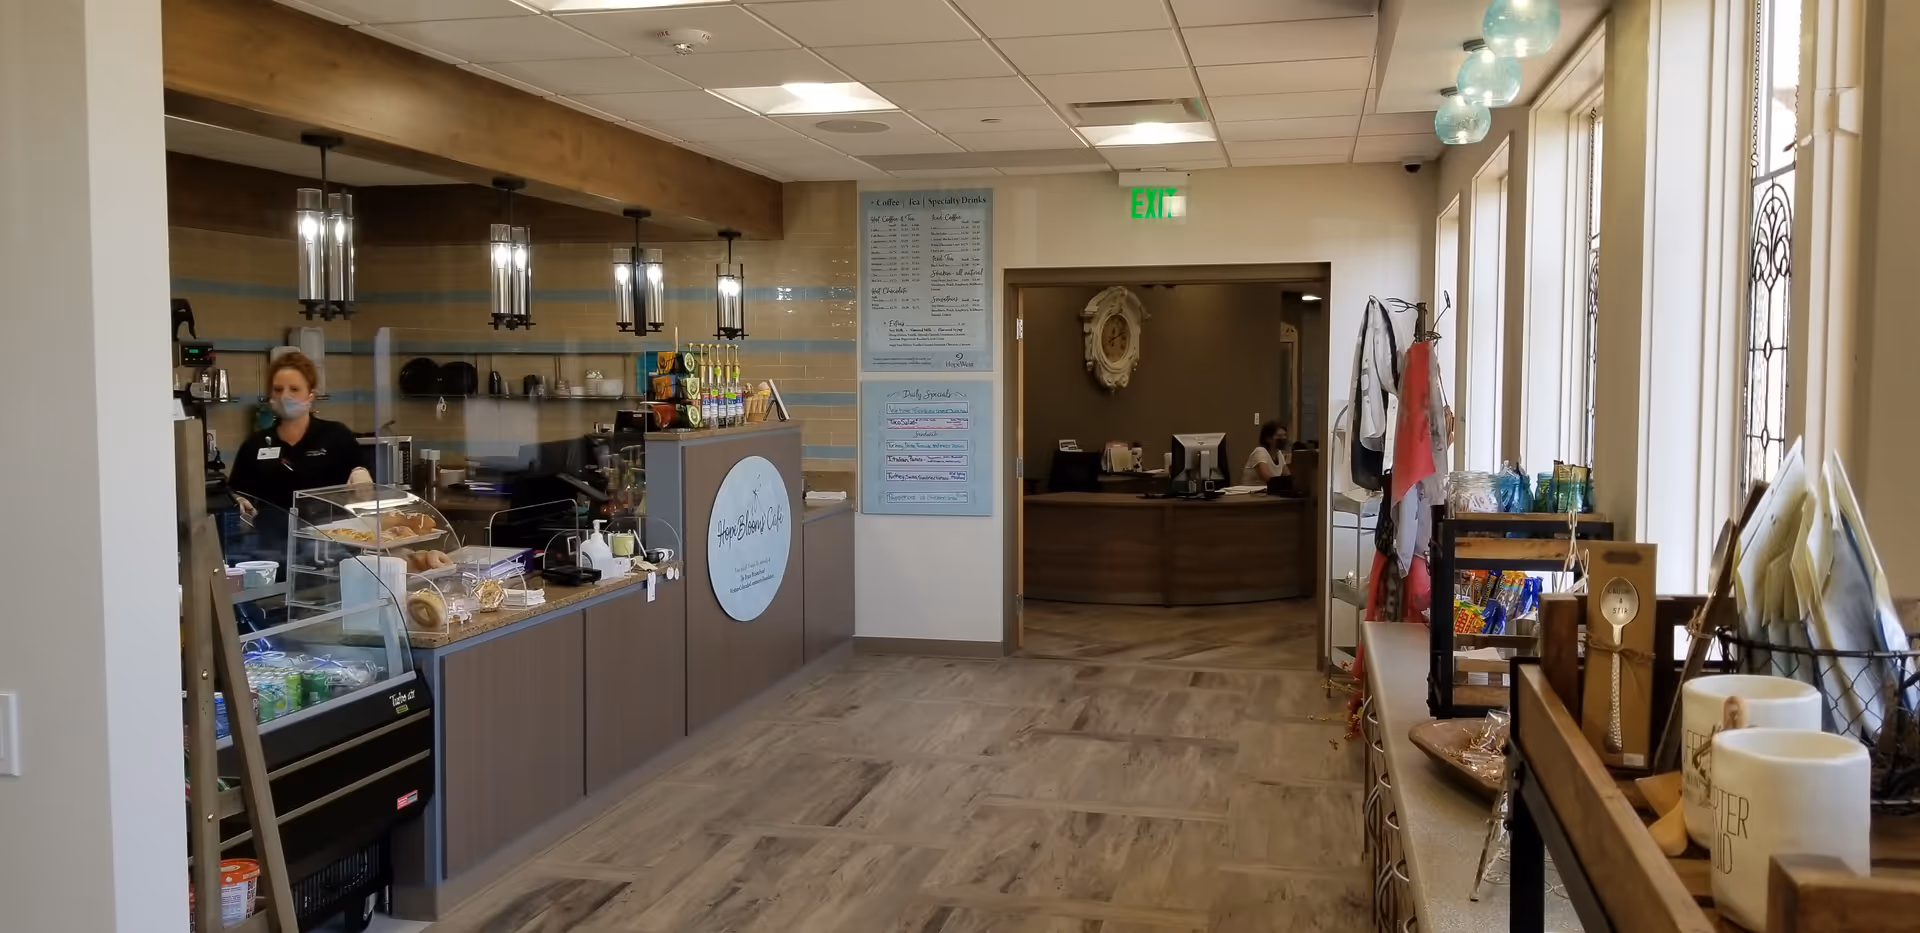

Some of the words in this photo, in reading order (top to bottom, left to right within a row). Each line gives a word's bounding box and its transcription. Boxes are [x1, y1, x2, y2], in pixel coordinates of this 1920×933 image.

[877, 197, 900, 206] Coffee
[909, 197, 921, 206] Tea
[928, 195, 959, 207] Specialty
[961, 195, 987, 205] Drinks
[1131, 188, 1177, 219] EXIT
[870, 216, 880, 224] Hot
[882, 215, 898, 224] Coffee
[905, 213, 915, 221] Tea
[931, 214, 943, 222] Iced
[945, 214, 962, 222] Coffee
[967, 268, 984, 276] natural
[883, 287, 908, 295] Chocolate
[931, 296, 958, 304] Smoothies
[945, 361, 974, 370] HopeWest
[903, 389, 921, 400] Daily
[923, 389, 952, 400] Specials
